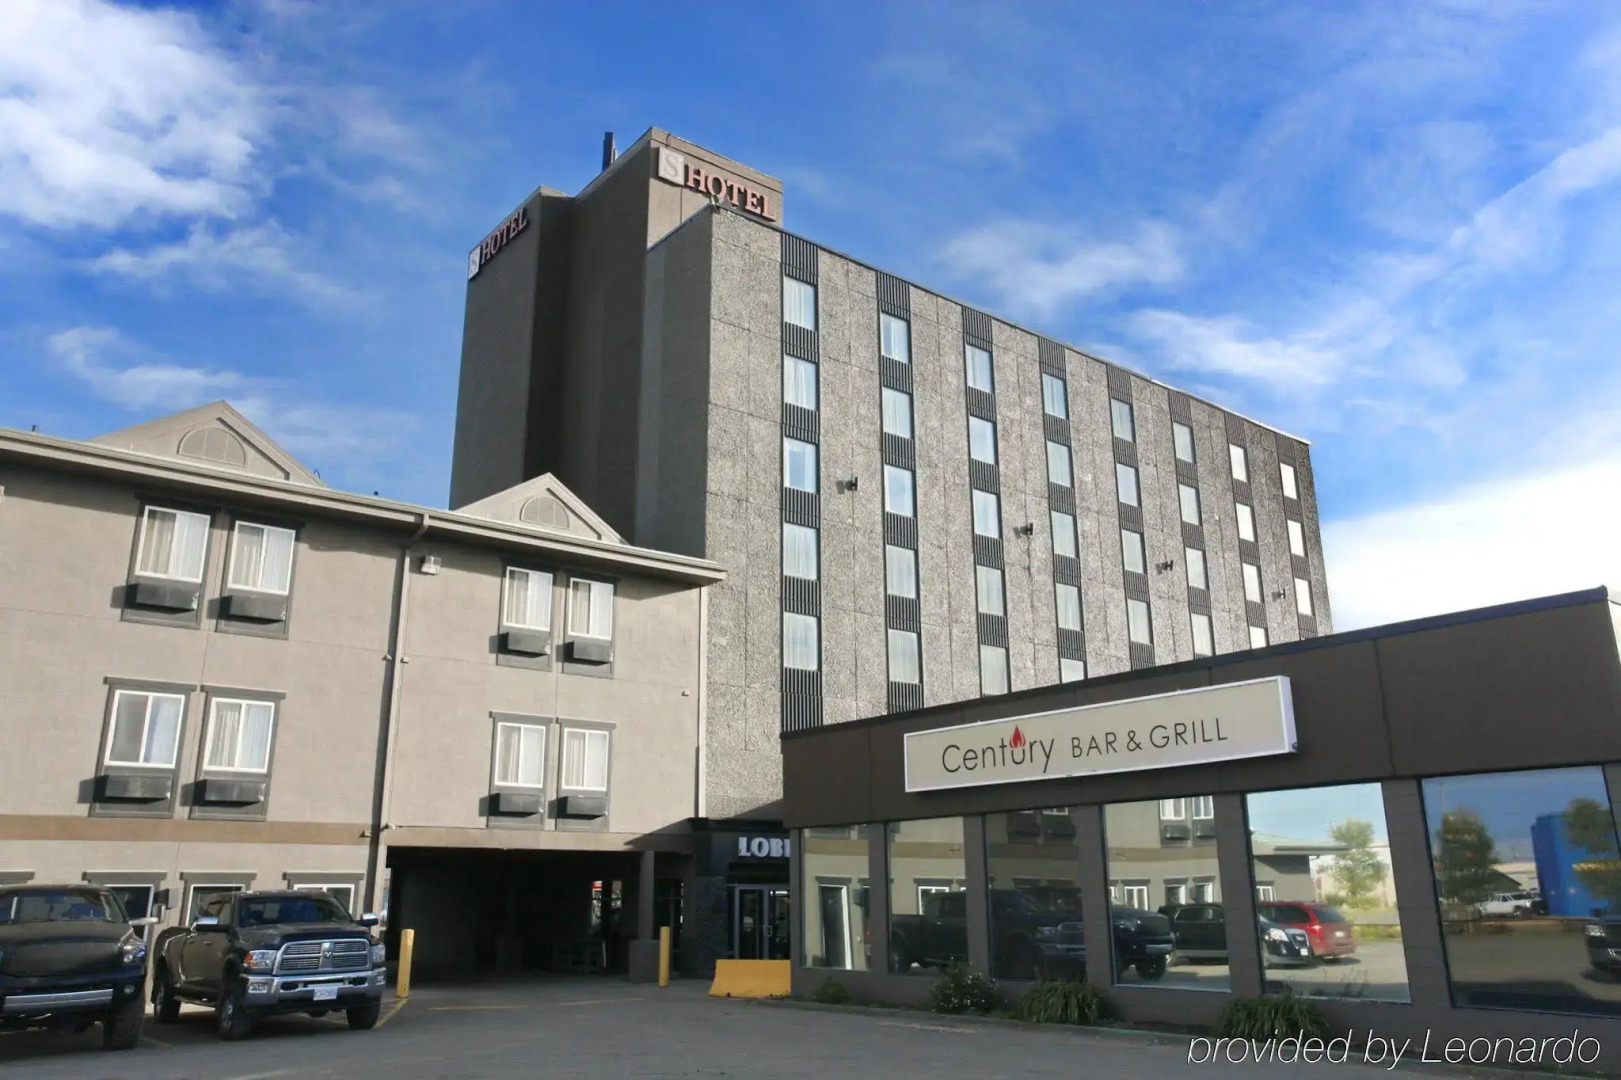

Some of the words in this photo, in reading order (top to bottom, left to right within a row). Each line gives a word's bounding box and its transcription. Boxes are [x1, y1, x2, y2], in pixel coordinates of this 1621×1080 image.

[686, 163, 777, 221] HOTEL
[480, 208, 527, 265] HOTEL
[942, 737, 1055, 774] Century
